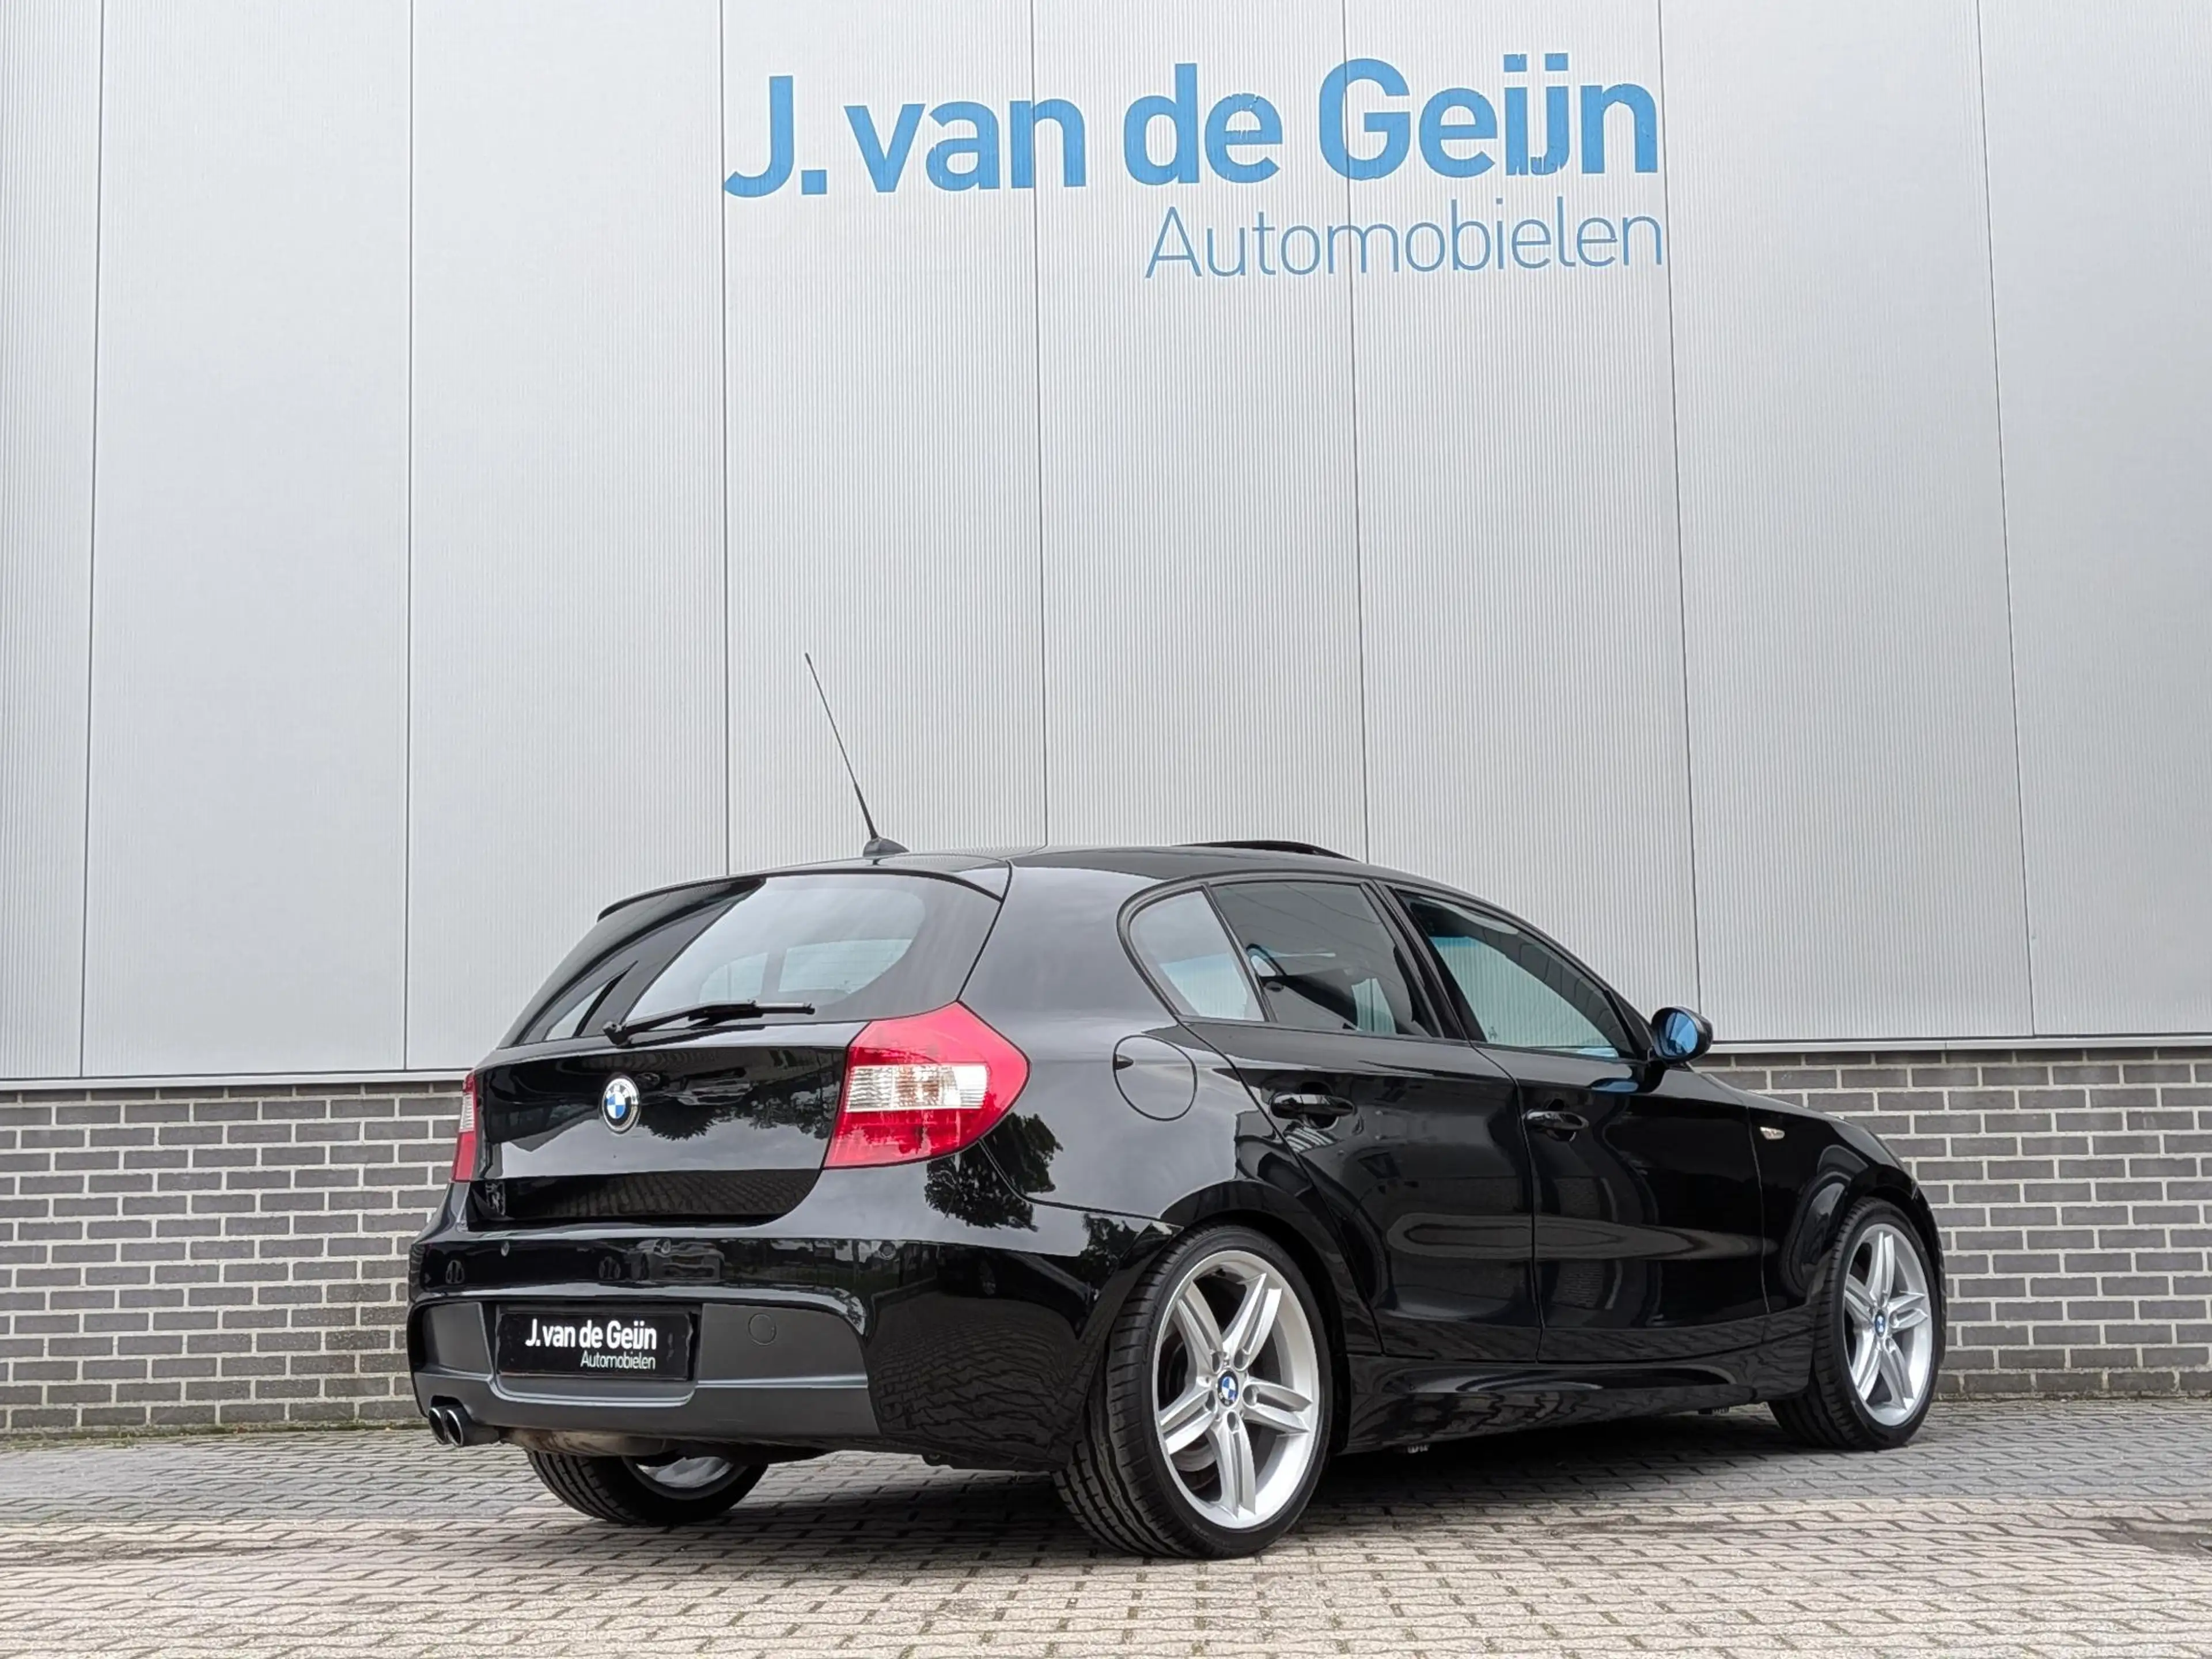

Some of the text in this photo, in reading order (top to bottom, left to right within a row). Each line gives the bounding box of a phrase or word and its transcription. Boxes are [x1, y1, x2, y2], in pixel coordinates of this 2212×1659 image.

[721, 52, 1660, 199] J. van de Geijn
[1145, 196, 1663, 278] Automobielen
[542, 1324, 575, 1348] van
[578, 1319, 604, 1349] de
[606, 1320, 657, 1350] Geijn
[580, 1350, 656, 1370] Automobielen
